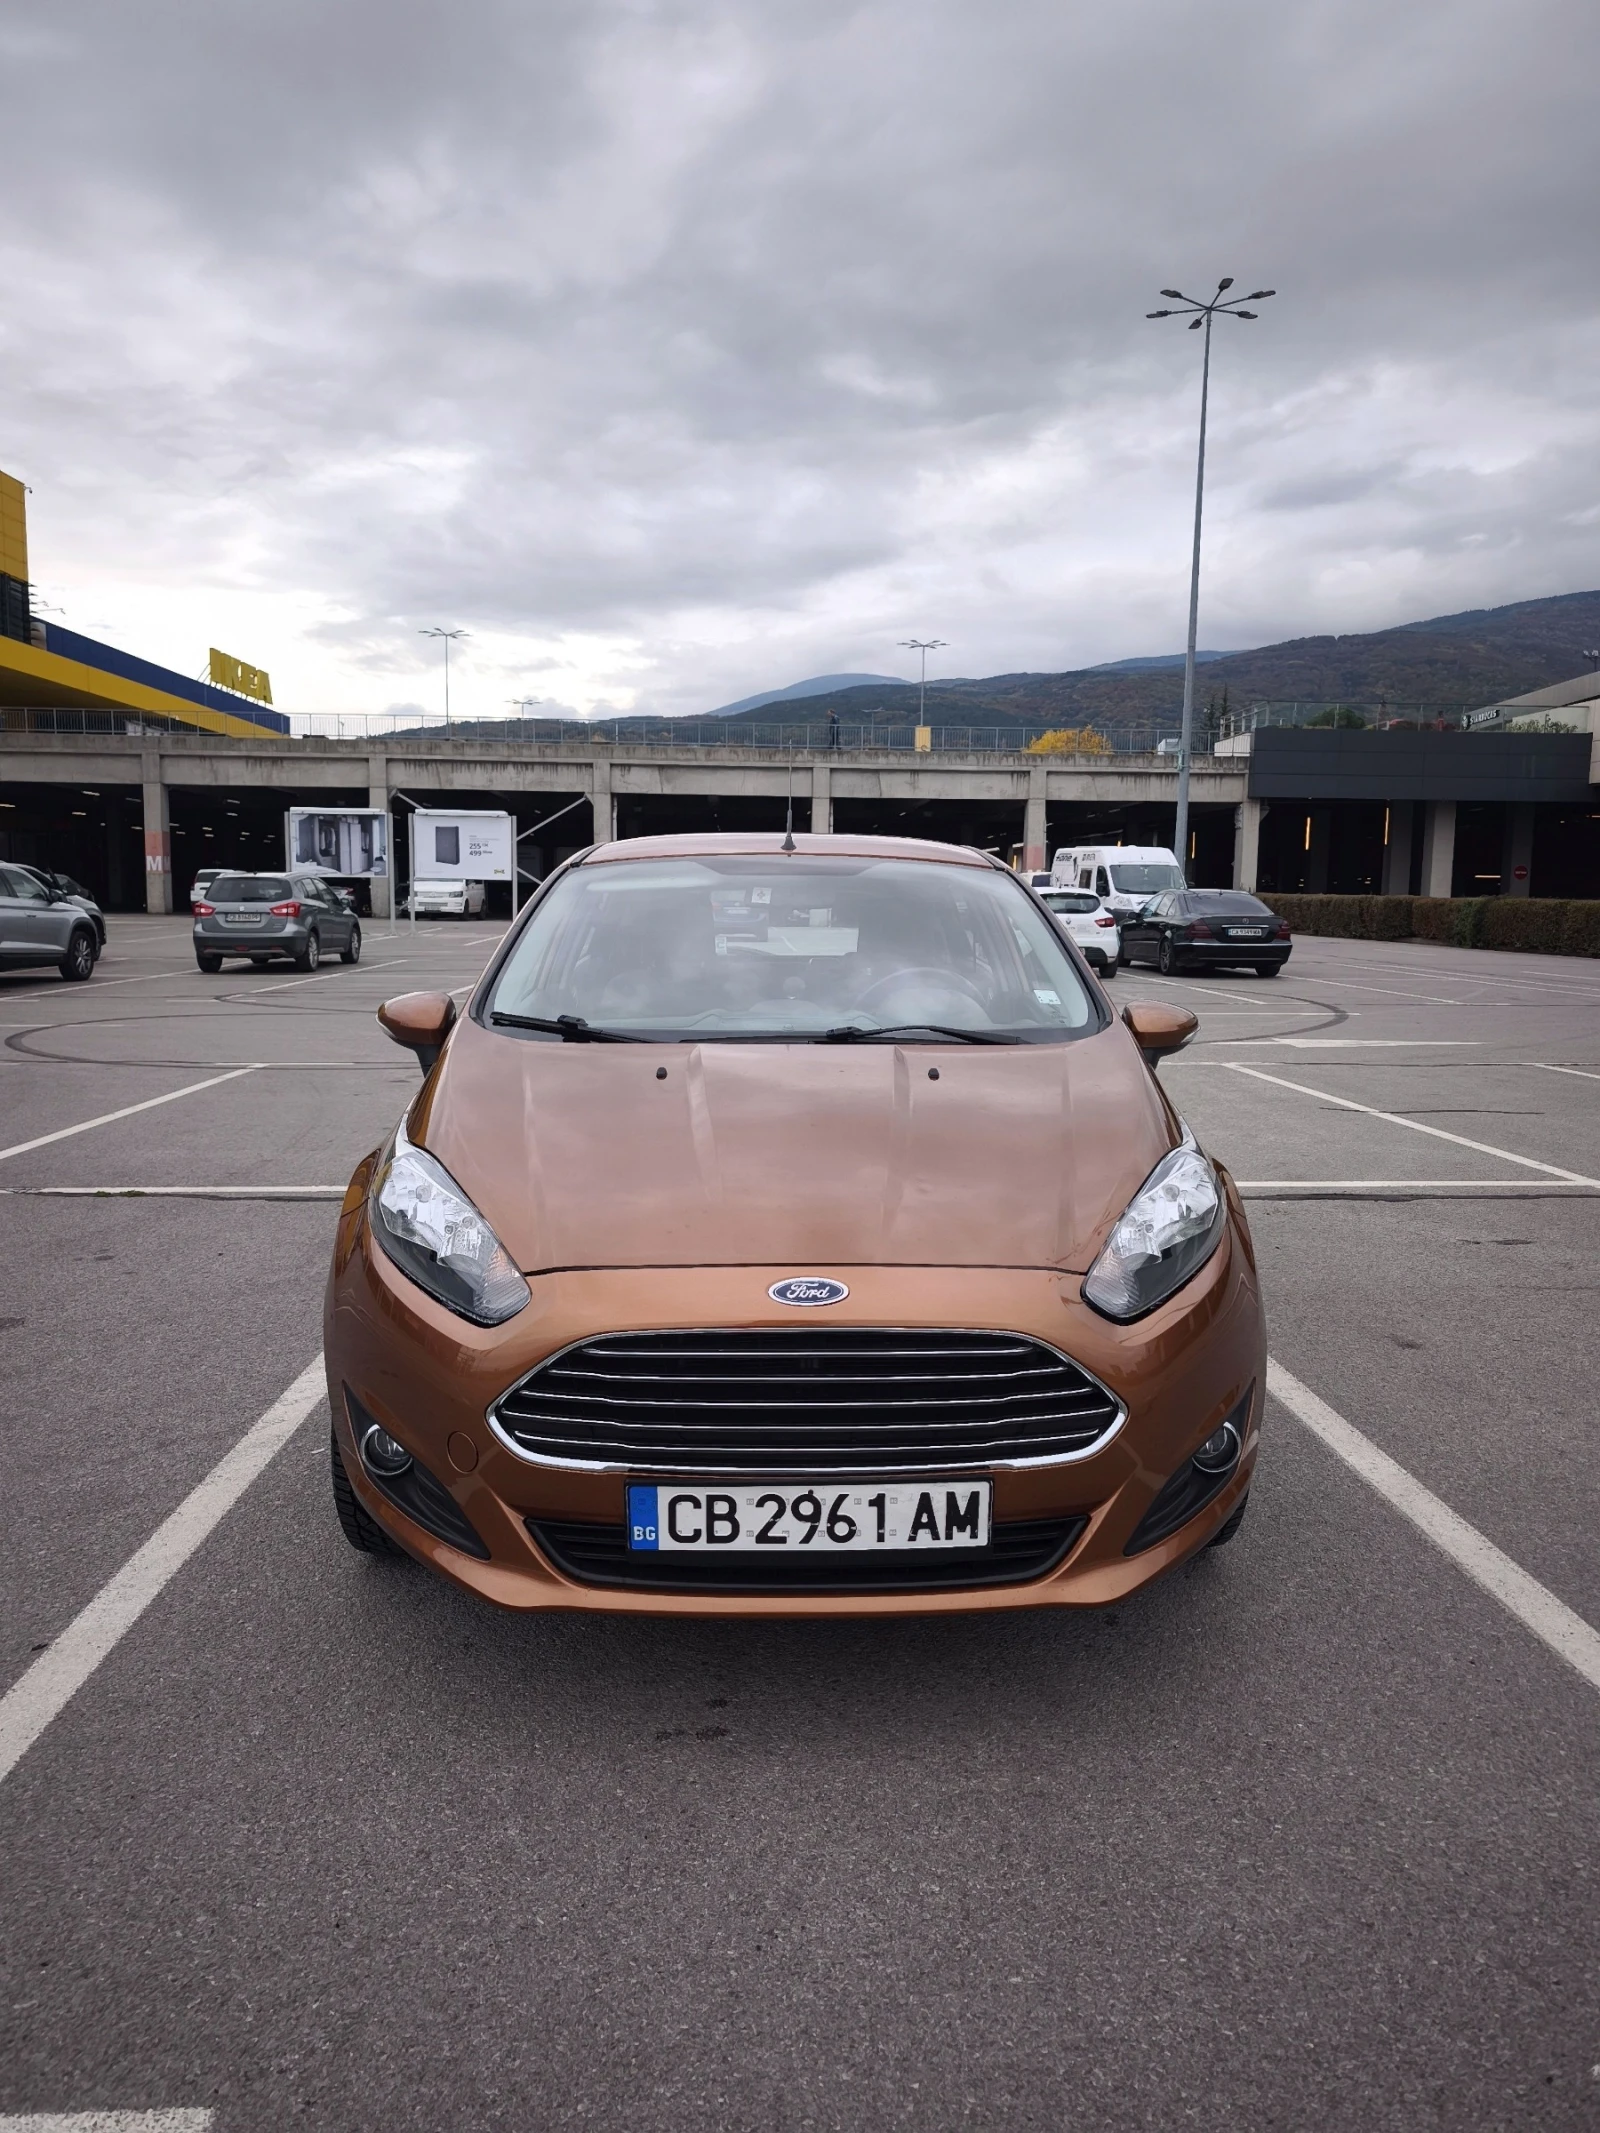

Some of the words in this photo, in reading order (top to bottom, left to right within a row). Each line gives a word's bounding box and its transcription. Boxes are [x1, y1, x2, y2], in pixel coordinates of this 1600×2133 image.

[209, 647, 273, 705] IKEA
[146, 855, 162, 871] M
[786, 1282, 830, 1299] Ford
[668, 1493, 740, 1544] CB
[755, 1492, 886, 1544] 2961
[907, 1490, 980, 1541] AM
[633, 1525, 656, 1541] BG
